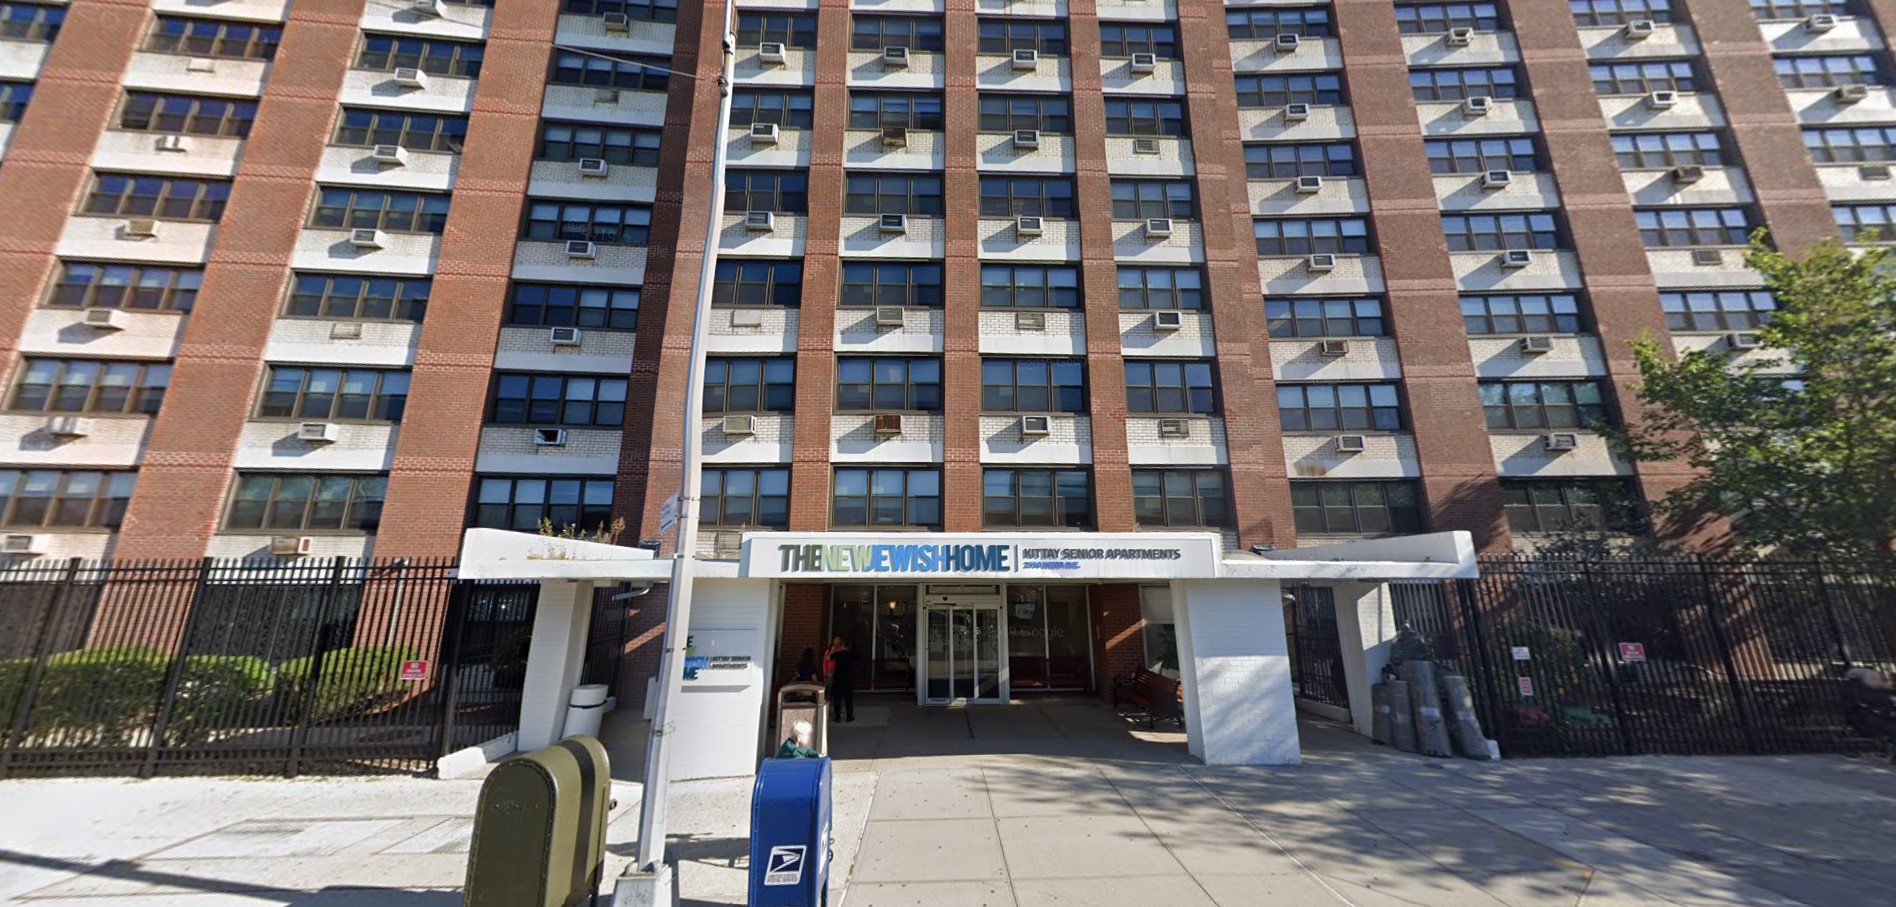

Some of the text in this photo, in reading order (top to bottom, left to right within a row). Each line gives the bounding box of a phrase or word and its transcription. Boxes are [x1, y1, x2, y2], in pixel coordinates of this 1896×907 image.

[1022, 548, 1181, 561] KITTAY SENIOR APARTMENTS
